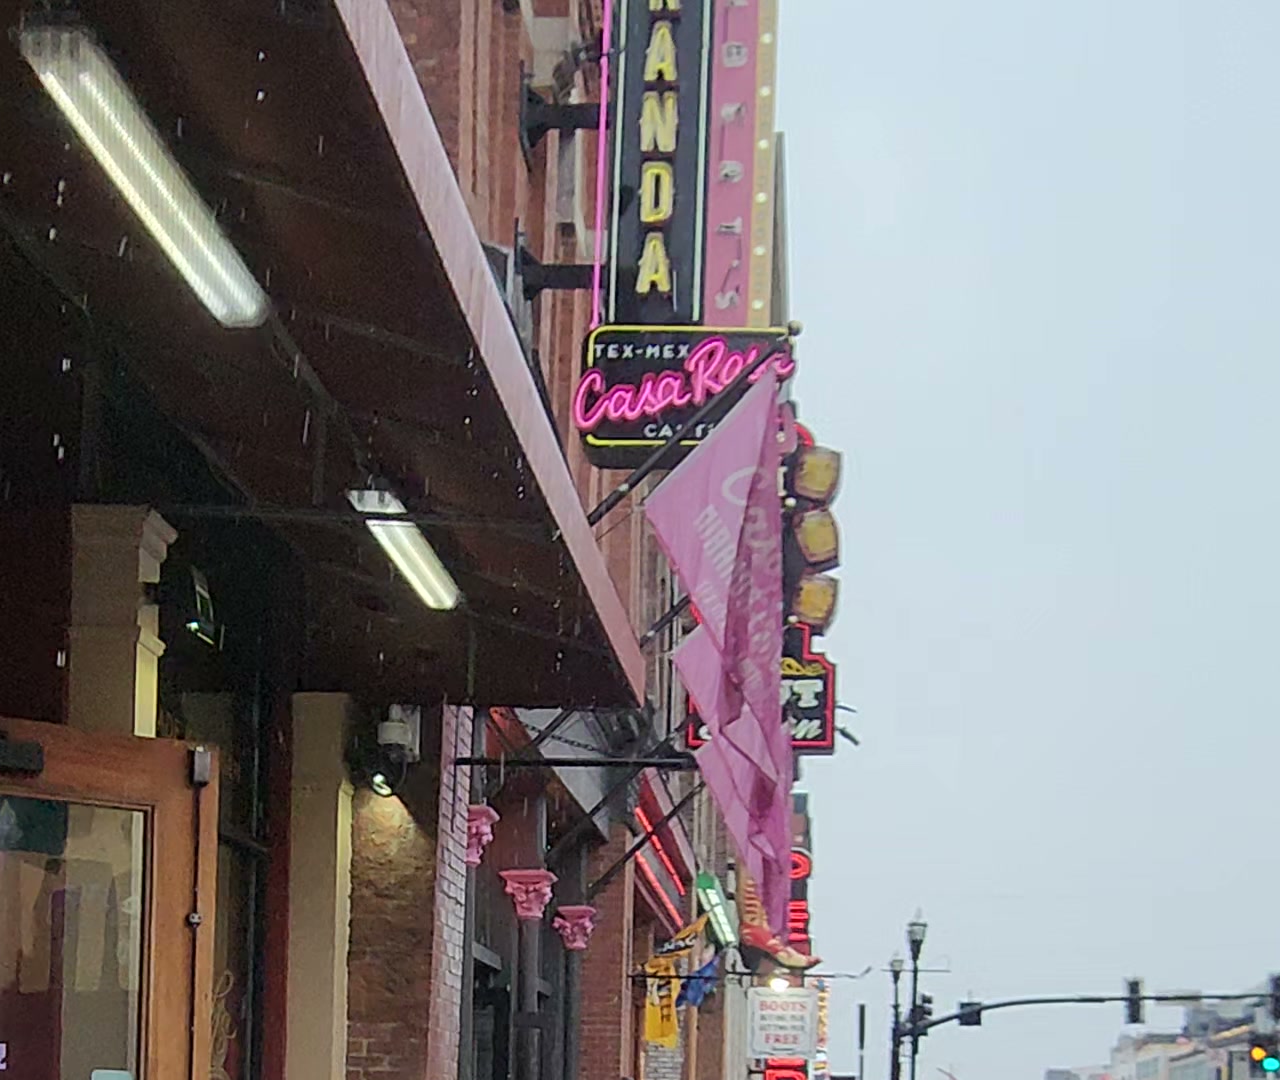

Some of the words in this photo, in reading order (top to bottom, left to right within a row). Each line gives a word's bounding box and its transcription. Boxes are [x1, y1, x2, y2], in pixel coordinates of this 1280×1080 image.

[635, 0, 680, 297] ANDA
[593, 343, 691, 360] TEX-MEX
[574, 367, 692, 430] Casa
[758, 1000, 808, 1012] BOOTS
[763, 1033, 801, 1045] FREE
